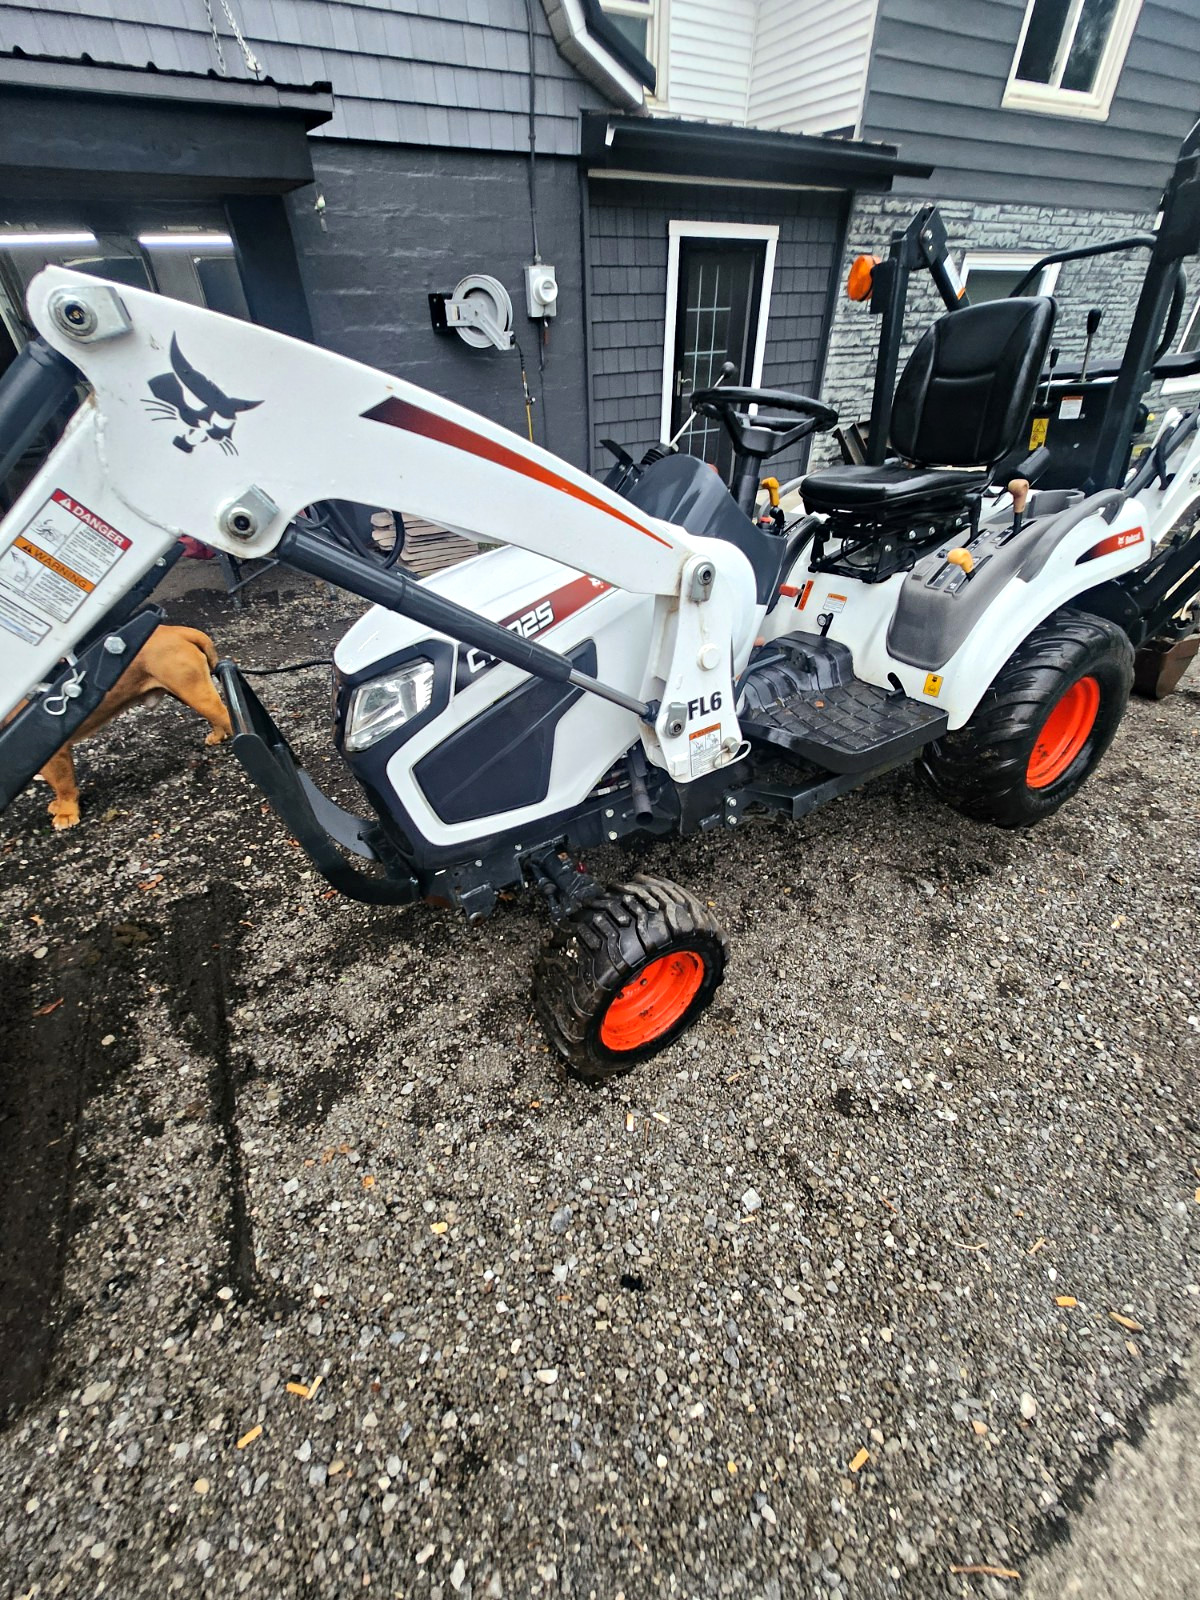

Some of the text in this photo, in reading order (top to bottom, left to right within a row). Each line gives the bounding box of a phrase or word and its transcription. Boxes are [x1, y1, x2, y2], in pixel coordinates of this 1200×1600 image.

[72, 506, 124, 546] DANGER
[34, 550, 87, 588] WARNING
[688, 691, 722, 720] FL6
